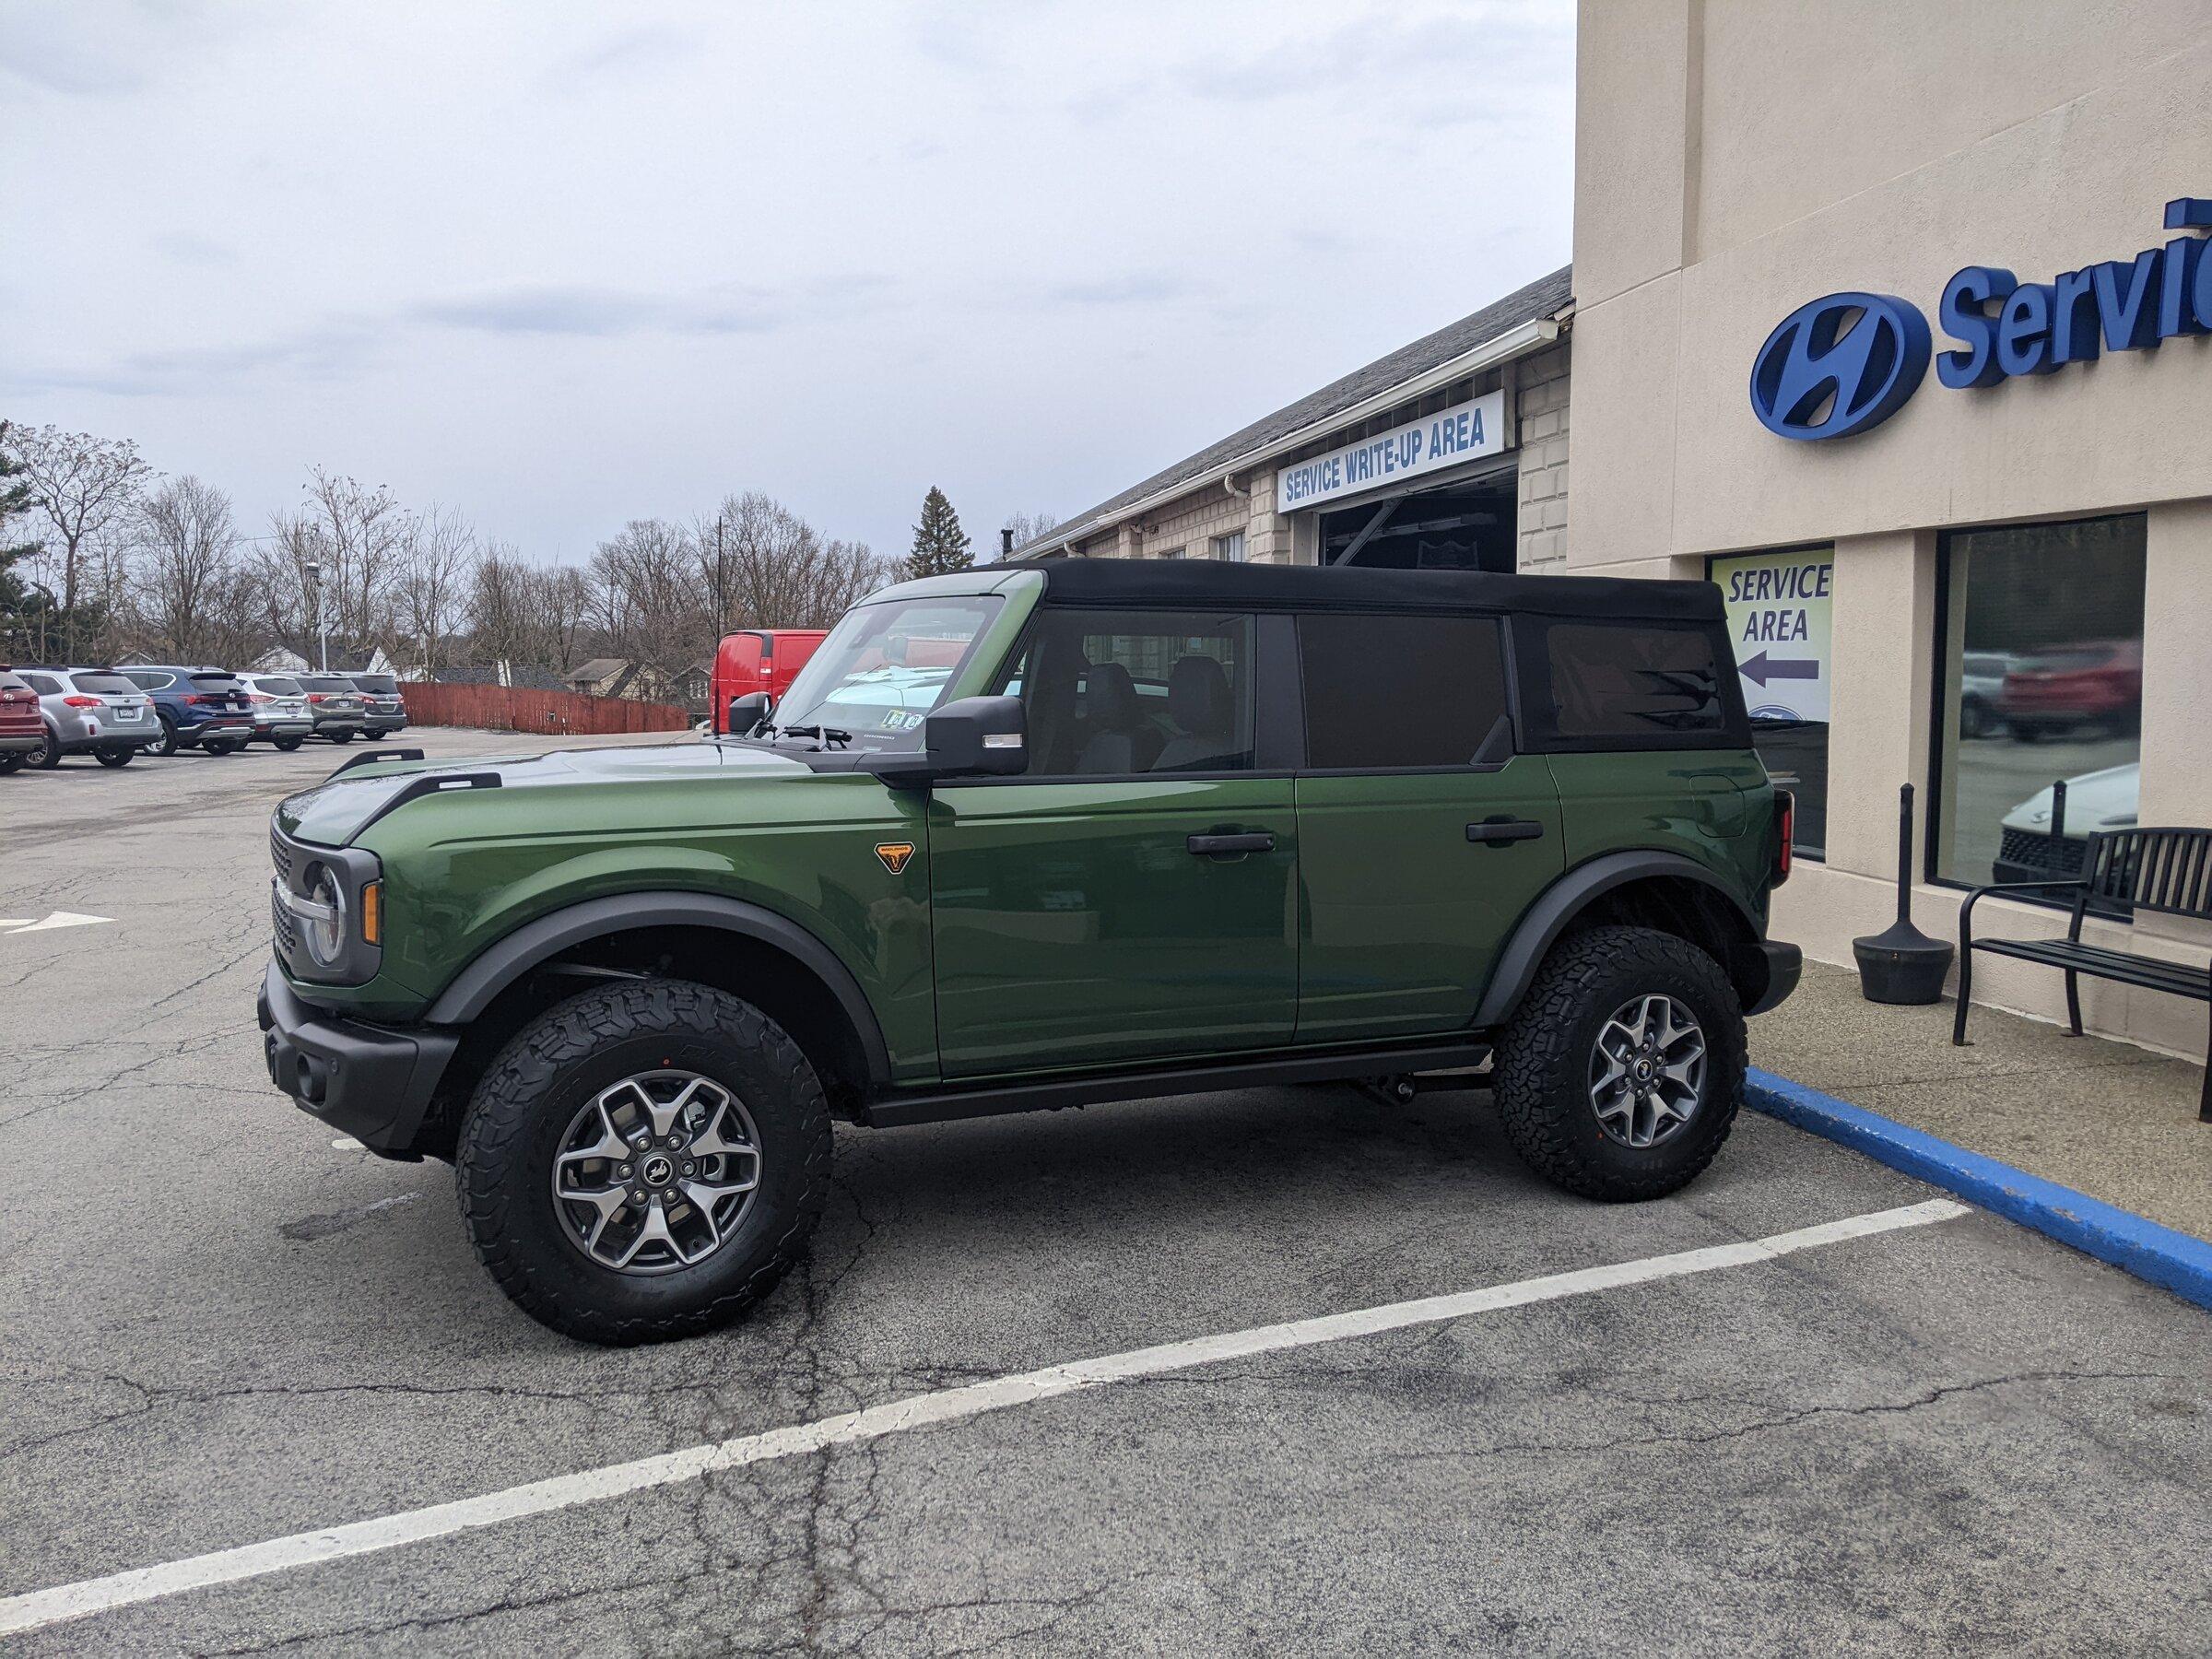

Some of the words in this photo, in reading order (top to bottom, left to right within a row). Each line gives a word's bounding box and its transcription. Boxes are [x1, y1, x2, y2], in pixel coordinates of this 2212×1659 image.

[1286, 457, 1341, 502] SERVICE
[1345, 429, 1422, 484] WRITE-UP
[1429, 407, 1485, 460] AREA
[1728, 564, 1832, 603] SERVICE
[1742, 608, 1808, 641] AREA
